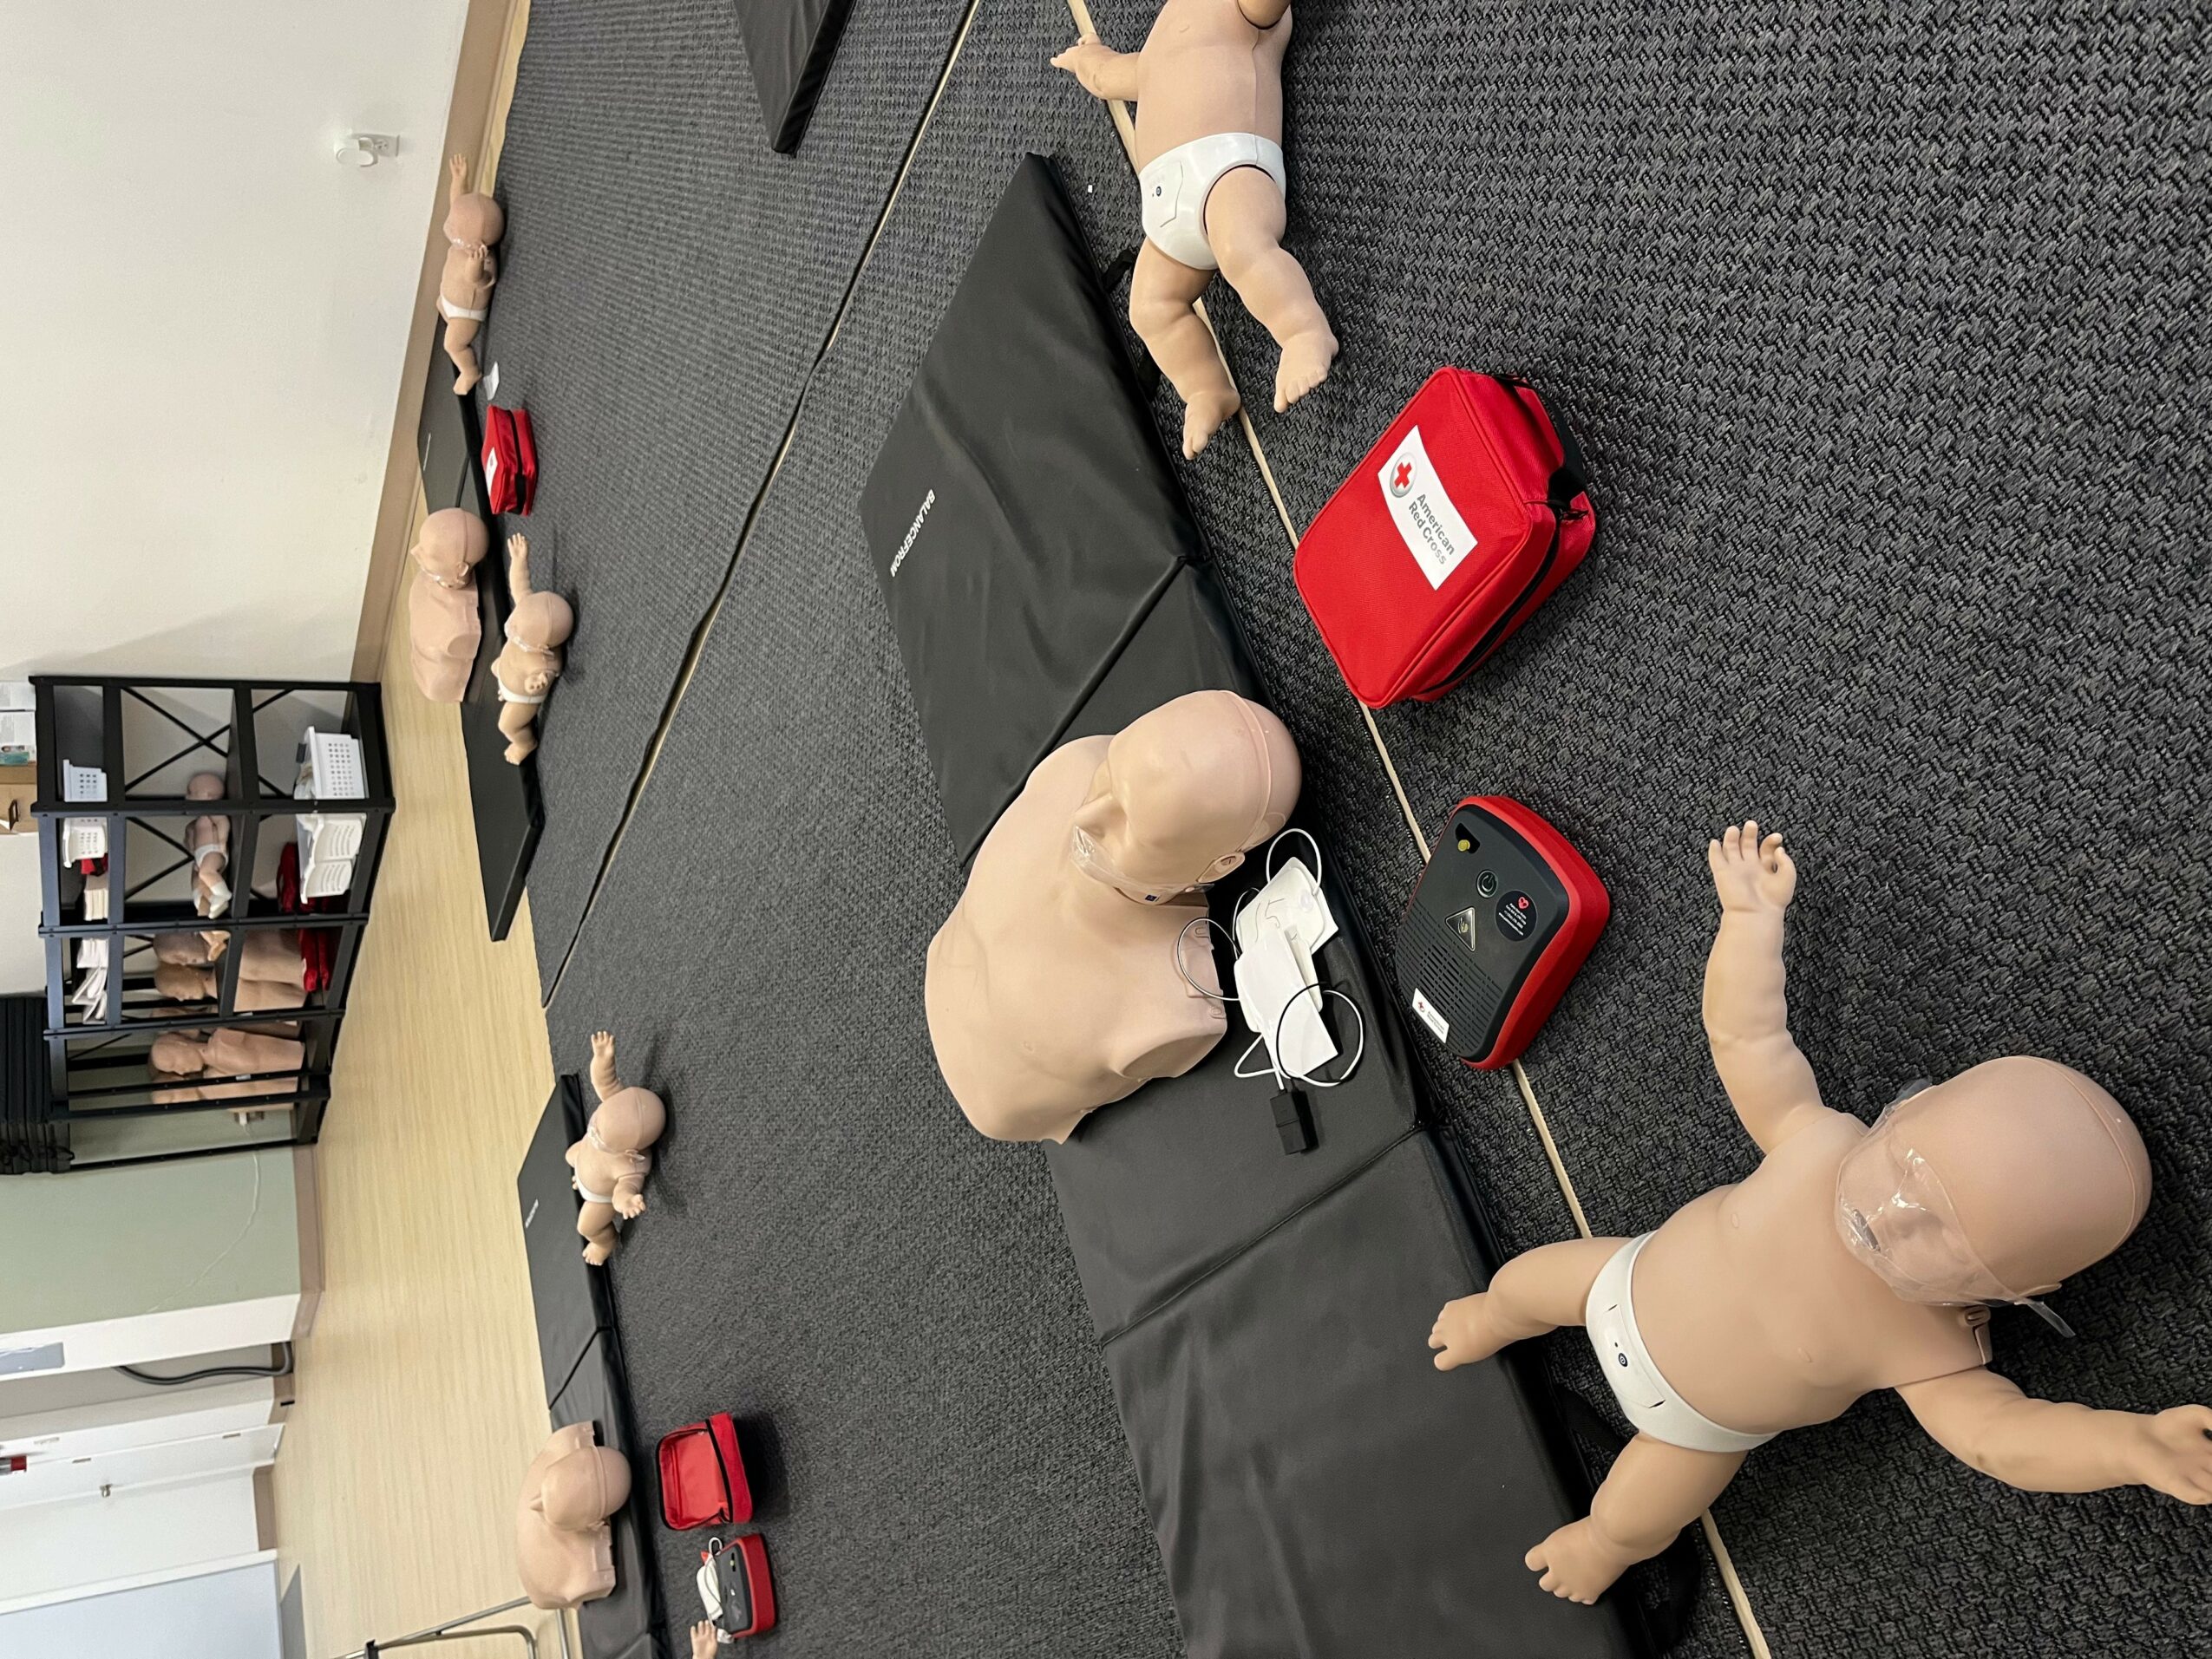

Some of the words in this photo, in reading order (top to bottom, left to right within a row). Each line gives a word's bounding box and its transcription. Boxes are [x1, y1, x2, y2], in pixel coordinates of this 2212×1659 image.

[890, 489, 935, 578] BALANCEFROM
[1409, 501, 1426, 529] Red
[1422, 527, 1447, 565] Cross
[1417, 493, 1456, 555] American
